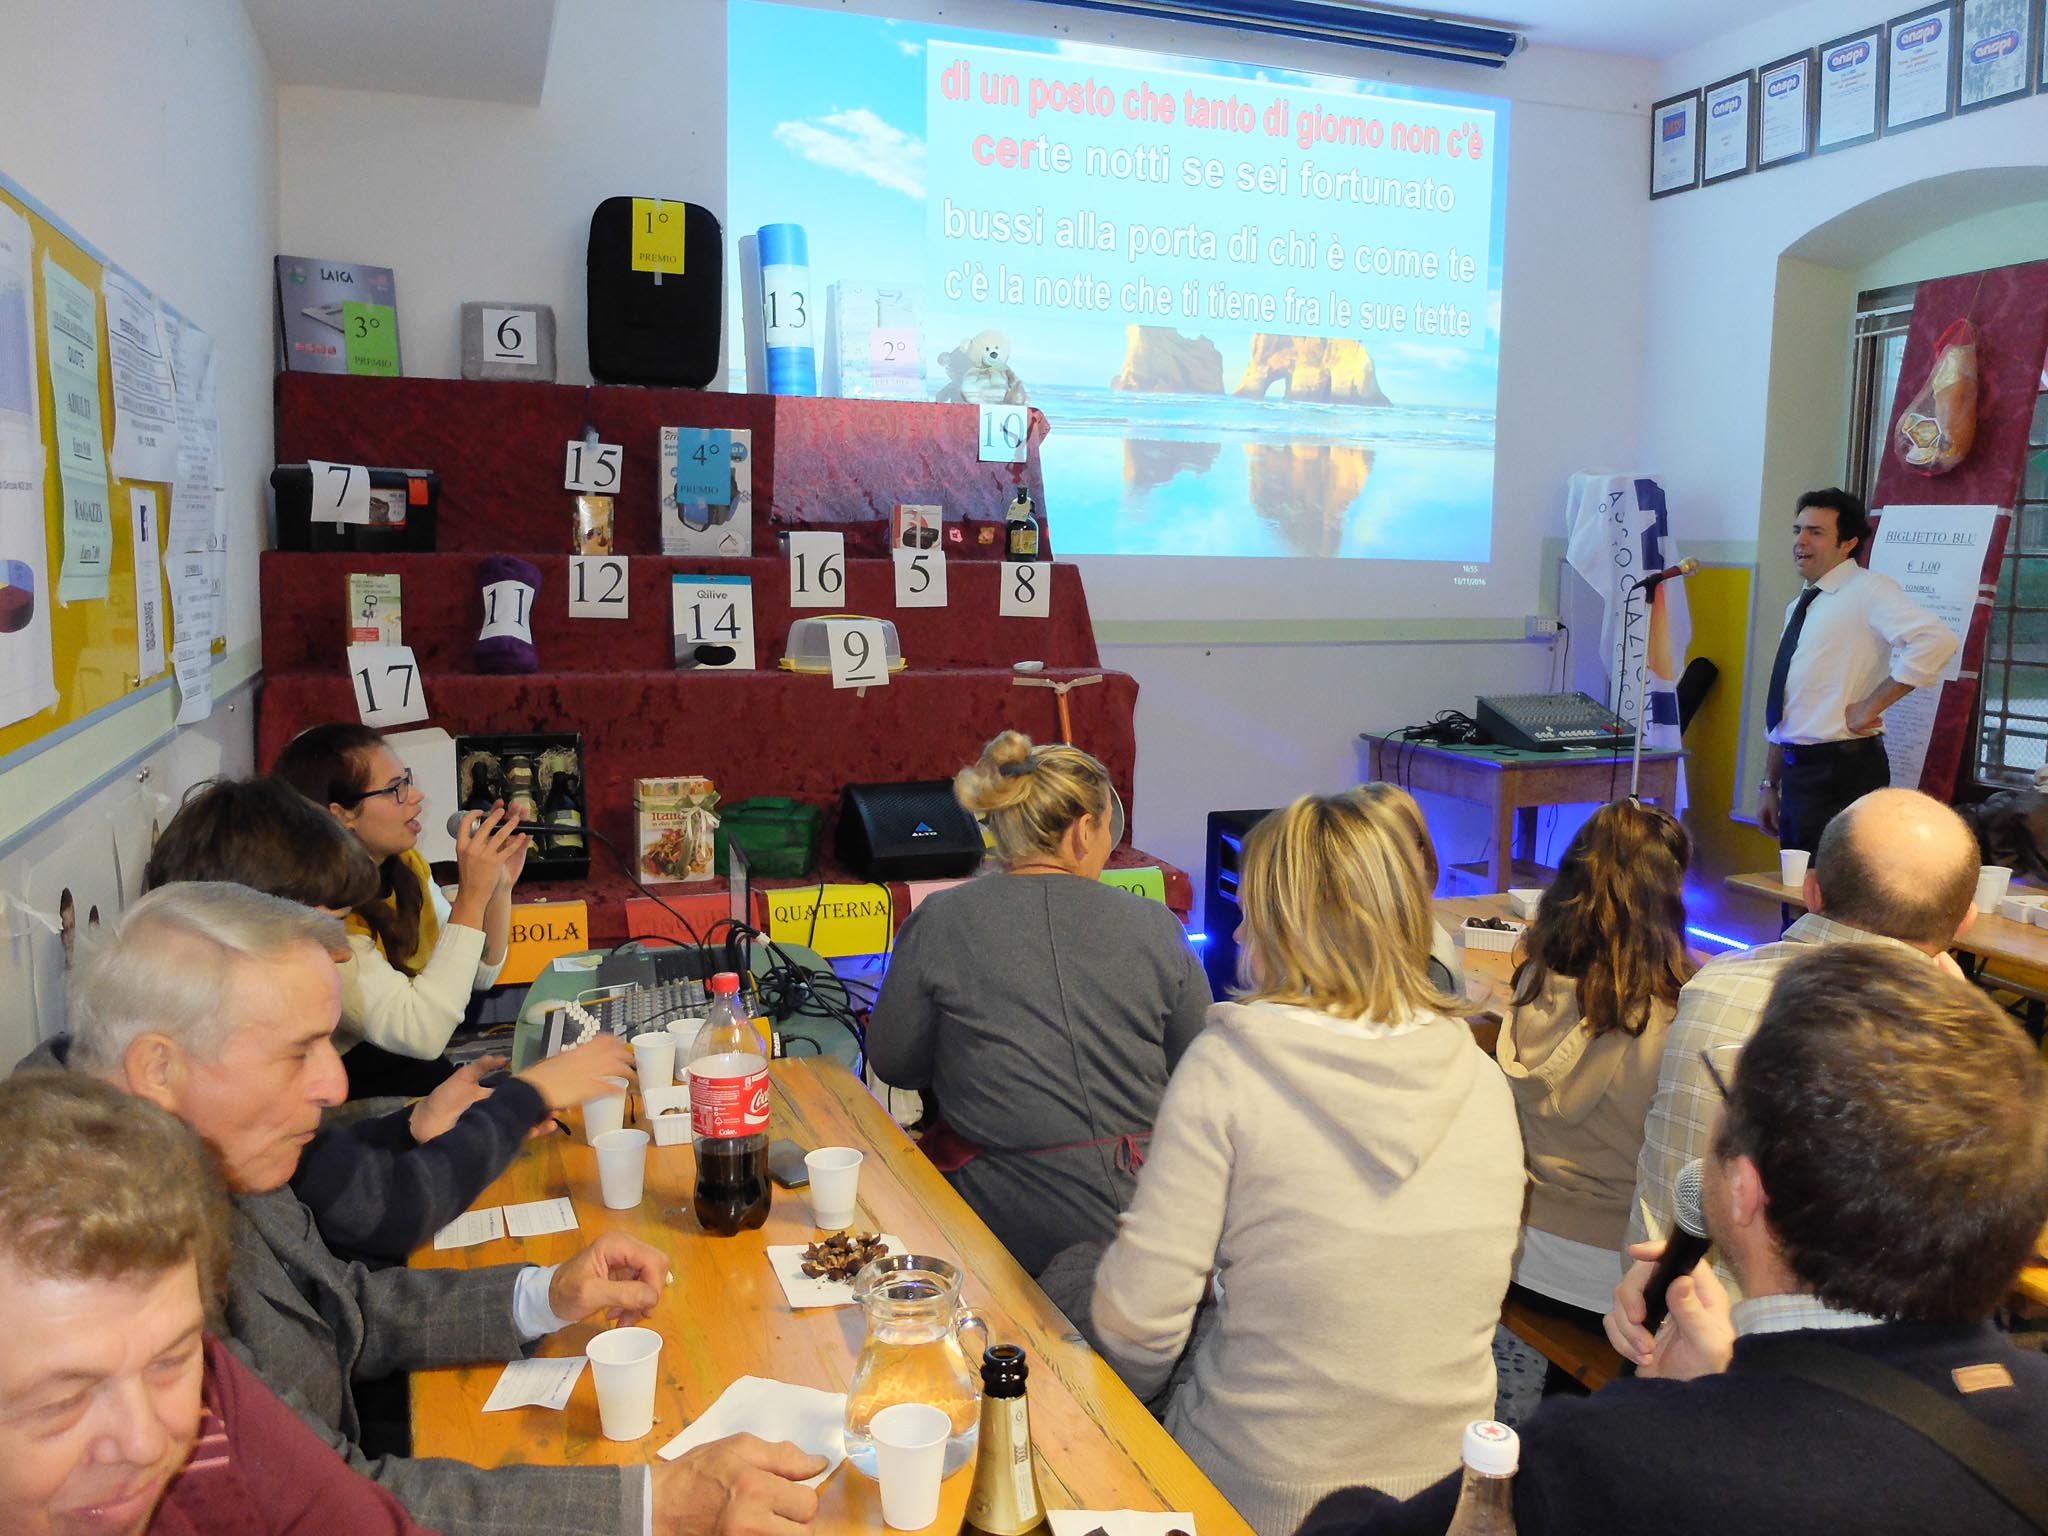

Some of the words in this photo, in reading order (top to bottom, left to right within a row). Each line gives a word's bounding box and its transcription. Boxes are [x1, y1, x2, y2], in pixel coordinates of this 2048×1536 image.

[941, 59, 970, 101] di
[980, 71, 1019, 106] un
[1028, 77, 1115, 119] posto
[1123, 82, 1175, 123] che
[1184, 88, 1256, 133] tanto
[1264, 98, 1289, 137] di
[1296, 104, 1383, 149] giorno
[1391, 120, 1440, 154] non
[1447, 122, 1483, 159] c'è
[973, 134, 1072, 172] certe
[1086, 144, 1170, 183] notti
[1182, 156, 1225, 188] se
[1235, 158, 1288, 195] sei
[1300, 160, 1455, 212] fortunato
[646, 212, 669, 234] 1°
[944, 198, 1043, 246] bussi
[1055, 210, 1116, 251] alla
[1128, 223, 1217, 262] porta
[1227, 225, 1258, 264] di
[1268, 230, 1317, 269] chi
[1326, 233, 1345, 271] è
[1354, 244, 1438, 279] come
[1449, 246, 1475, 282] te
[320, 268, 354, 283] LAICA
[639, 252, 677, 263] PREMIO
[767, 291, 806, 328] 13
[944, 261, 989, 302] c'è
[998, 264, 1024, 305] la
[1033, 272, 1112, 311] notte
[1120, 275, 1172, 315] che
[1181, 279, 1199, 317] ti
[1208, 281, 1276, 322] tiene
[1284, 287, 1320, 326] fra
[1329, 290, 1351, 328] le
[1360, 301, 1407, 333] sue
[1414, 300, 1471, 337] tette
[354, 316, 380, 338] 3°
[497, 315, 522, 350] 6
[355, 356, 392, 368] PREMIO
[884, 341, 906, 361] 2°
[983, 411, 1025, 449] 10
[570, 447, 618, 487] 15
[692, 444, 719, 466] 4°
[328, 465, 351, 508] 7
[680, 484, 719, 494] PREMIO
[1886, 530, 1947, 543] BIGLIETTO
[1952, 532, 1976, 544] BLU
[574, 562, 624, 603] 12
[793, 552, 843, 593] 16
[910, 555, 930, 593] 5
[1014, 564, 1035, 603] 8
[487, 588, 526, 627] 11
[697, 590, 728, 600] Qilive
[688, 602, 741, 641] 14
[843, 630, 869, 673] 9
[357, 664, 413, 713] 17
[775, 900, 889, 923] QUATERNA
[511, 921, 580, 943] BOLA
